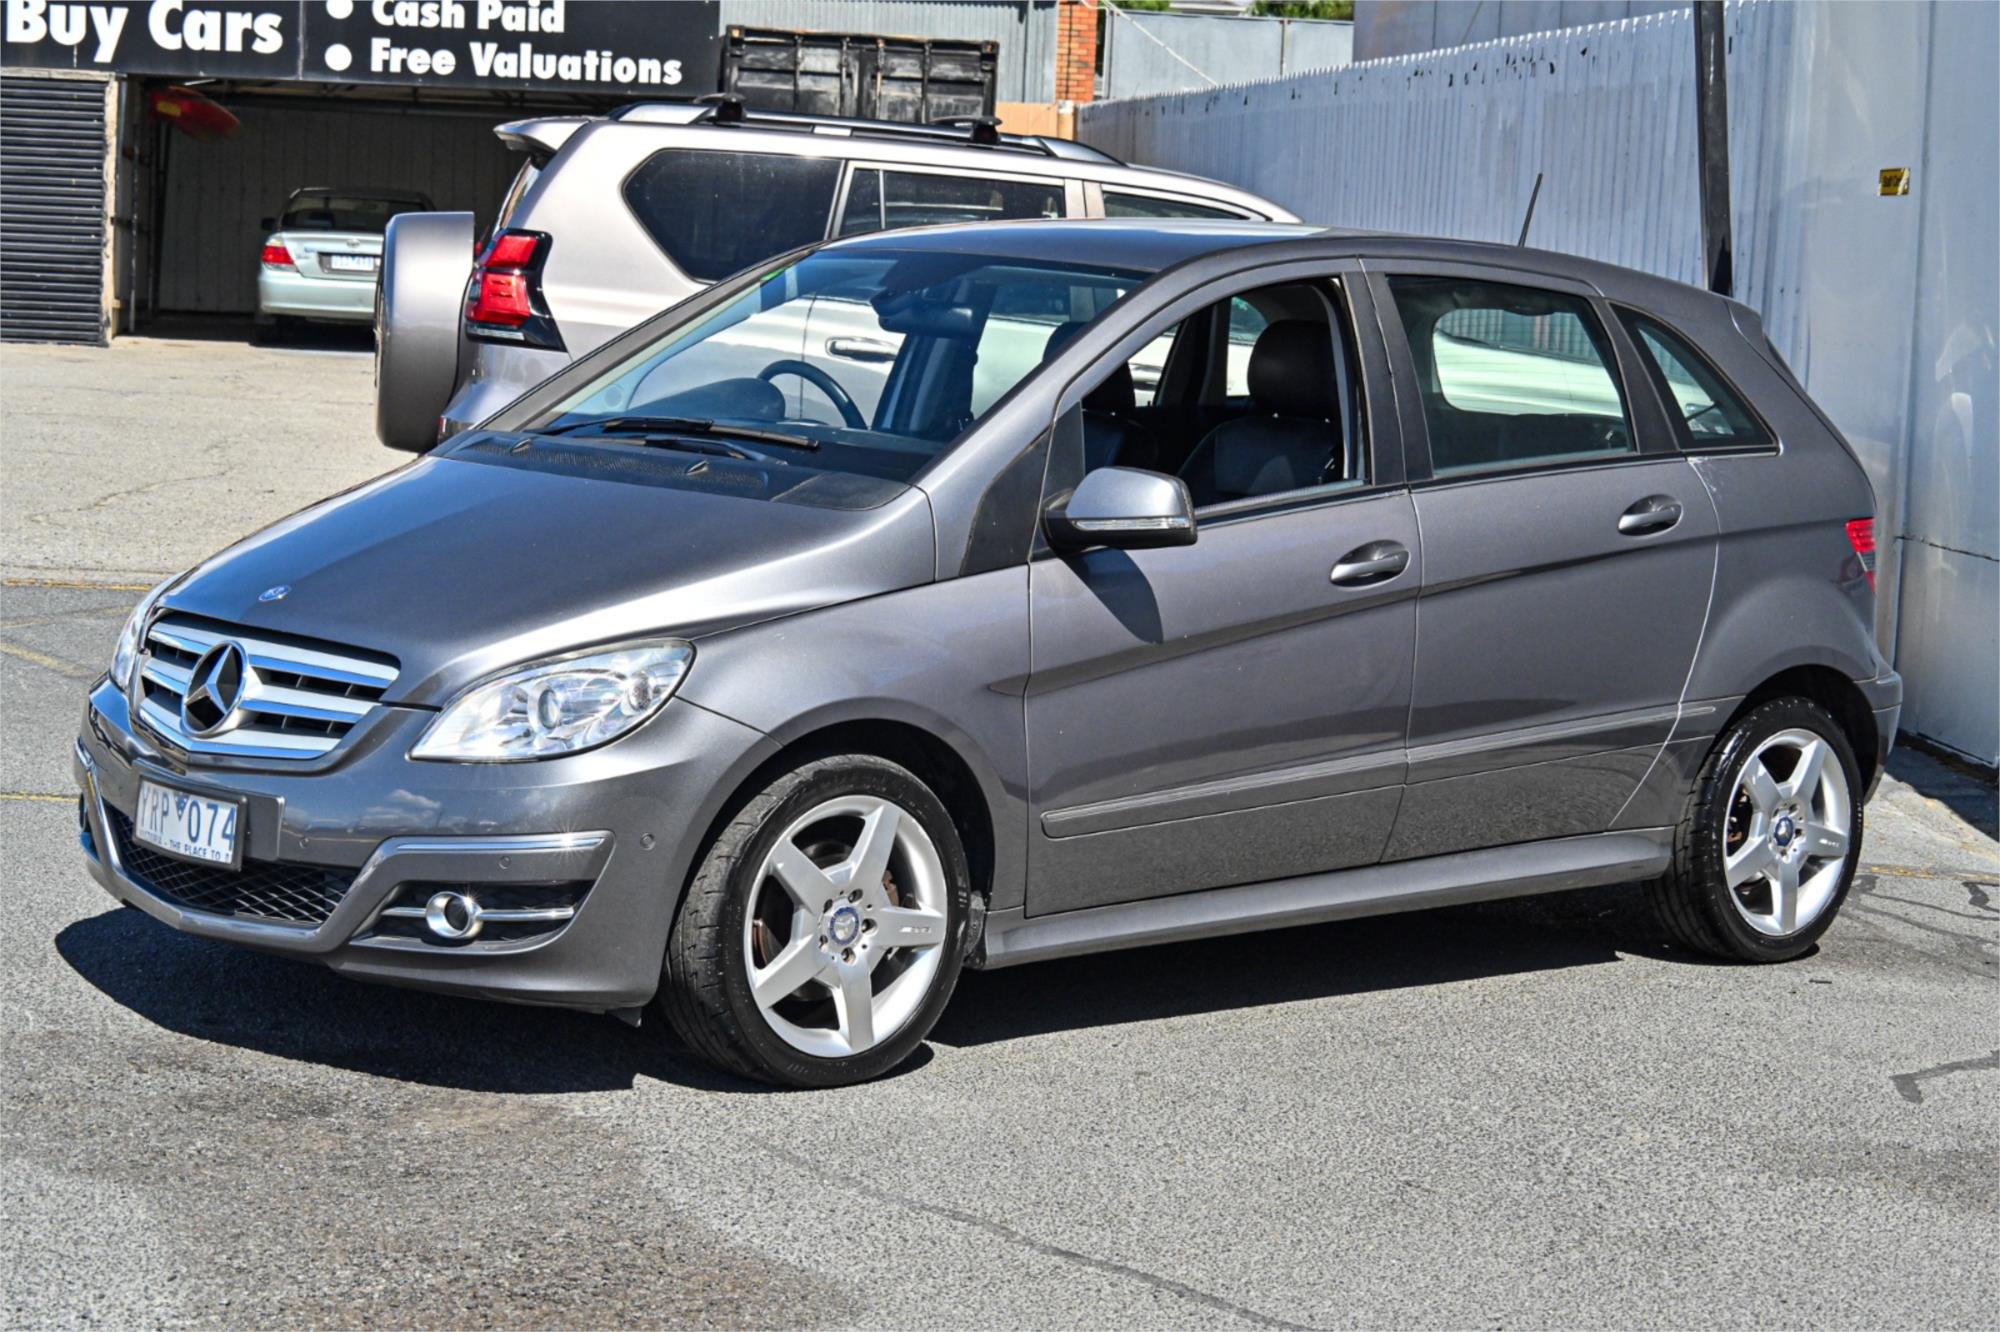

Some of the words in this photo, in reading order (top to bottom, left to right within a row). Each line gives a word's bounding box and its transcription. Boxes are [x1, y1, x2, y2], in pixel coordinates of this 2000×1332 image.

[6, 0, 129, 63] Buy
[148, 0, 283, 54] Cars
[372, 0, 465, 29] Cash
[477, 0, 565, 33] Paid
[370, 37, 456, 75] Free
[469, 41, 683, 85] Valuations
[140, 783, 170, 833] YRP
[188, 799, 237, 852] 074
